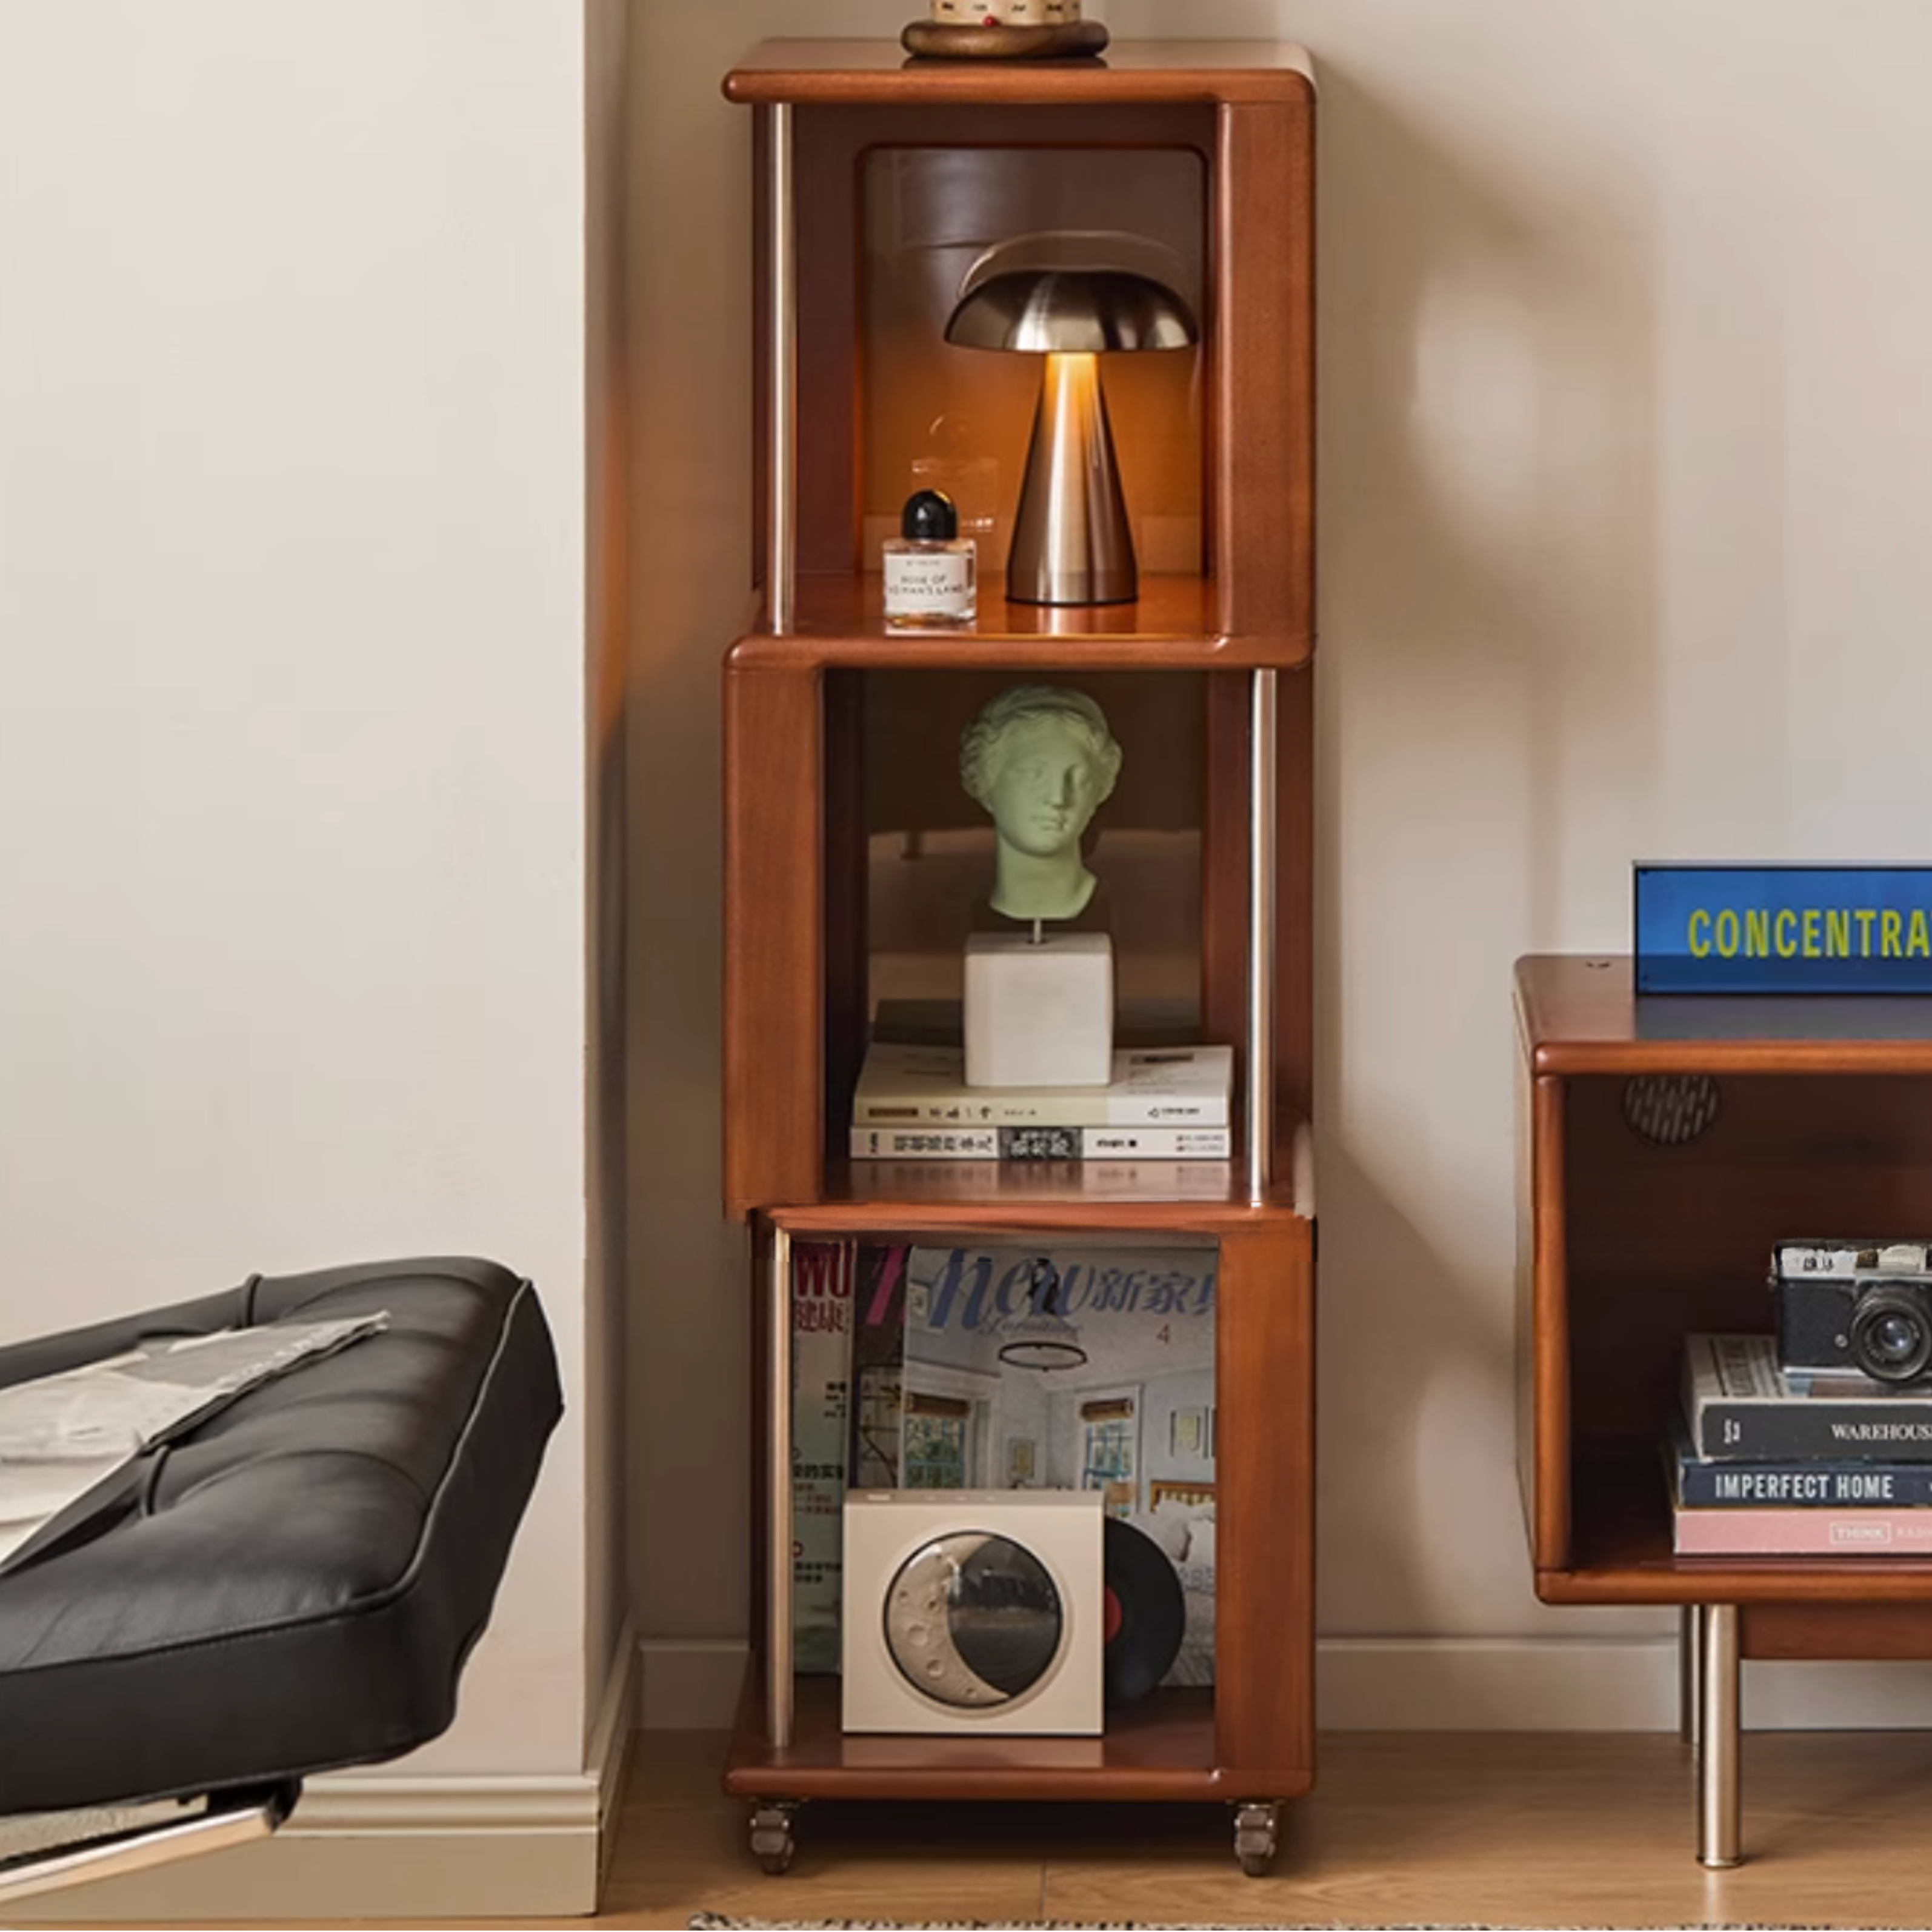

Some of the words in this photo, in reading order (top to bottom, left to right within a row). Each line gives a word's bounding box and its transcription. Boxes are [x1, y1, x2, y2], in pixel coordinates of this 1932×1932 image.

[1156, 1323, 1170, 1344] 4
[1715, 1474, 1830, 1499] IMPERFECT
[1837, 1474, 1894, 1499] HOME
